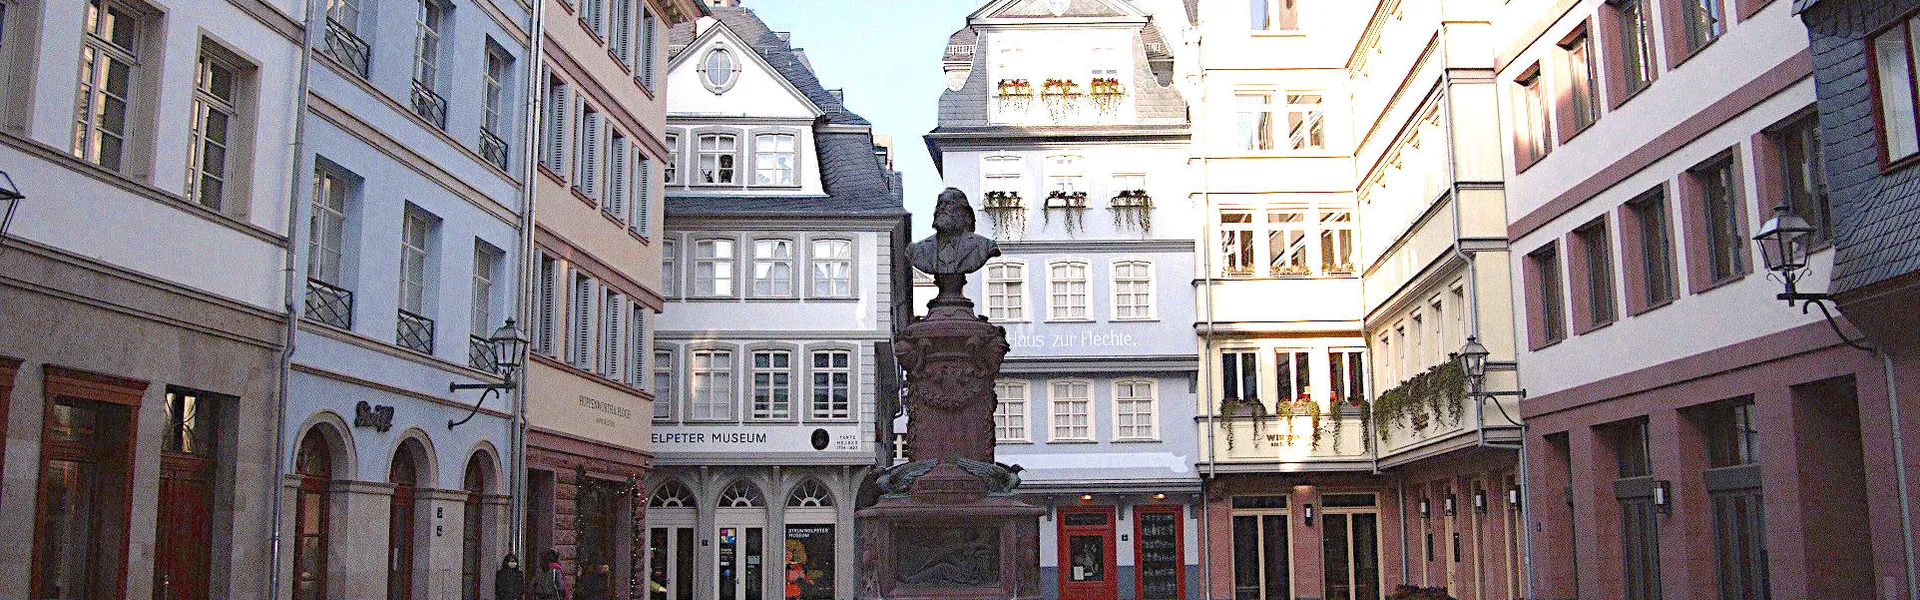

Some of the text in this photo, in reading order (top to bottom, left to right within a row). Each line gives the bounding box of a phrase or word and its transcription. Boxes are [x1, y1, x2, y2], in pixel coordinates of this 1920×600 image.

[1006, 330, 1045, 348] Haus
[1052, 333, 1077, 348] zur
[651, 433, 767, 443] ELPETER MUSEUM
